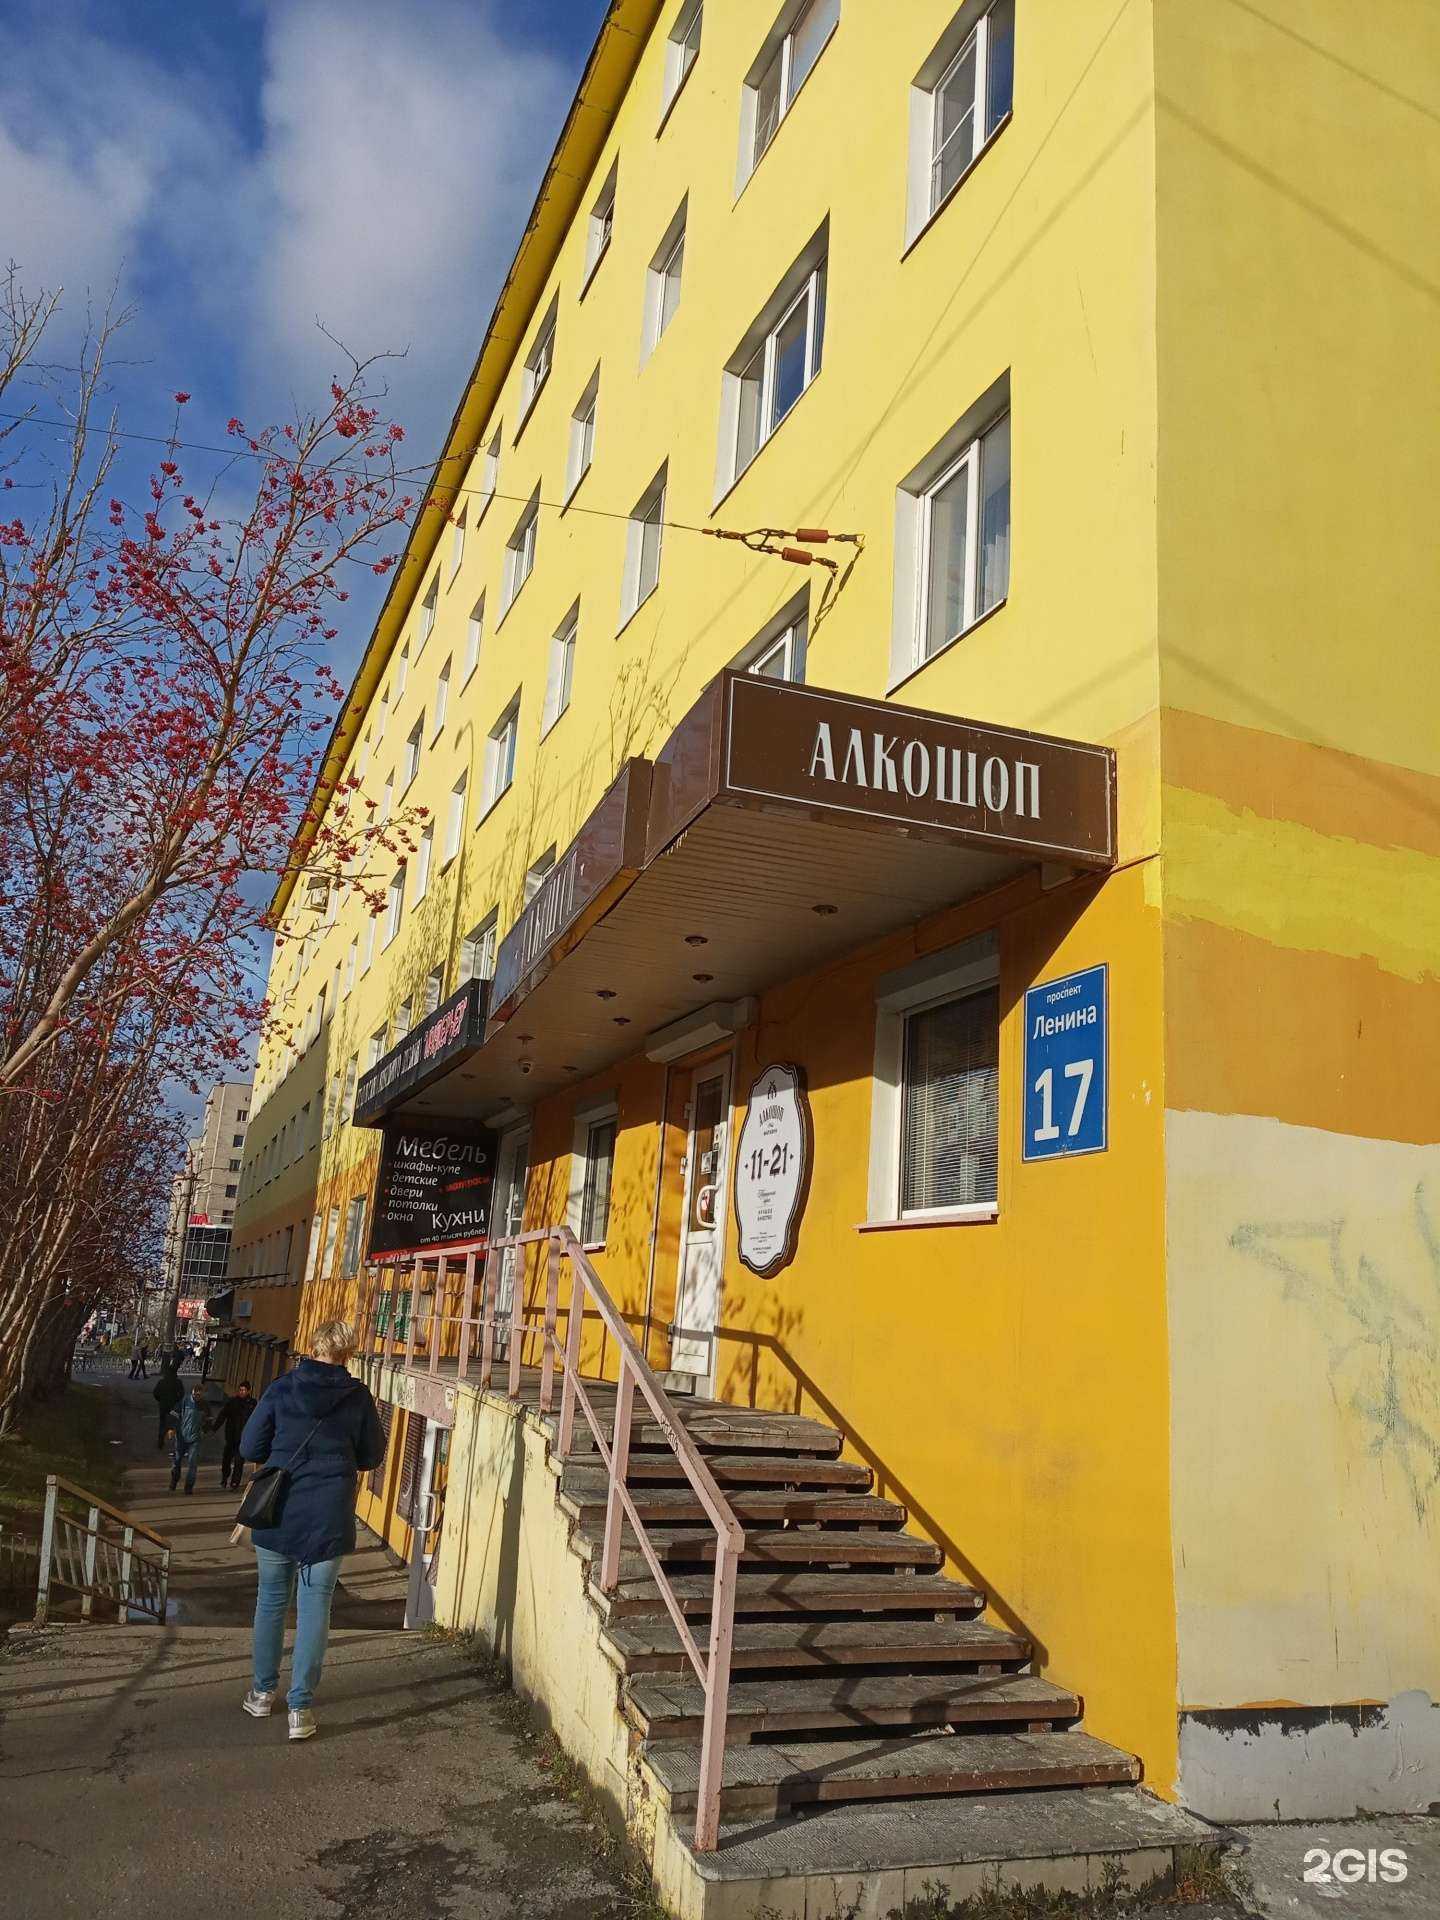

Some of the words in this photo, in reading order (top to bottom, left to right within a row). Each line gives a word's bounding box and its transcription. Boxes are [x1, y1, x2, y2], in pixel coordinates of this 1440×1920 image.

[809, 721, 1042, 820] АЛКОШОП
[1046, 983, 1082, 1004] проспект
[1033, 1004, 1097, 1040] Ленина
[1034, 1058, 1094, 1142] 17
[396, 1135, 488, 1164] Мебель
[393, 1160, 461, 1176] шкафы-купе
[751, 1142, 789, 1181] 11-21
[392, 1171, 438, 1186] детские
[390, 1184, 424, 1199] двери
[388, 1199, 439, 1212] потолки
[387, 1211, 414, 1222] окна
[463, 1227, 486, 1239] рублей
